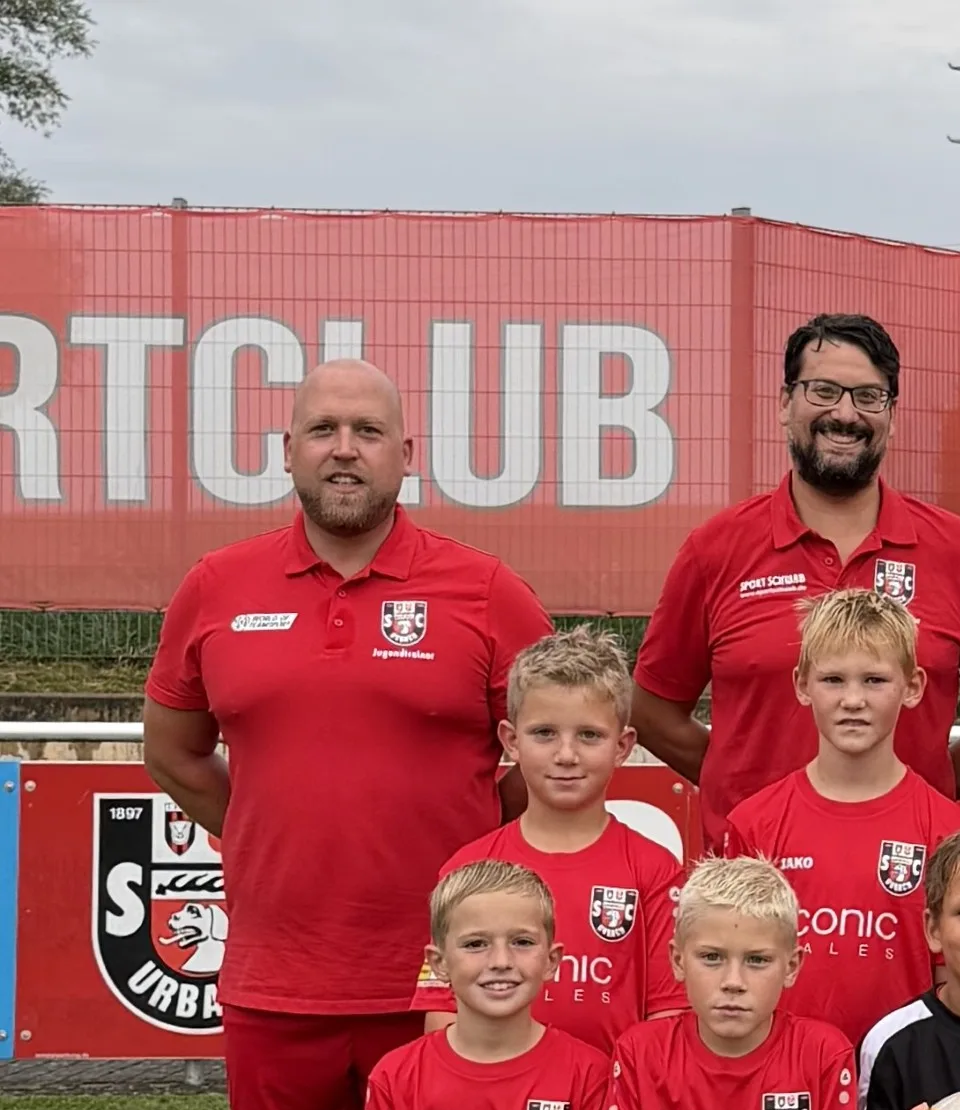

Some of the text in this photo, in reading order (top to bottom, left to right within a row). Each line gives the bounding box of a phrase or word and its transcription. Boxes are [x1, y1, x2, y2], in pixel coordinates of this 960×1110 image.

[109, 806, 144, 820] 1897
[780, 856, 814, 870] JAKO
[105, 861, 145, 937] S
[803, 942, 895, 960] ALES
[127, 960, 223, 1020] URBA
[544, 988, 611, 1004] LES
